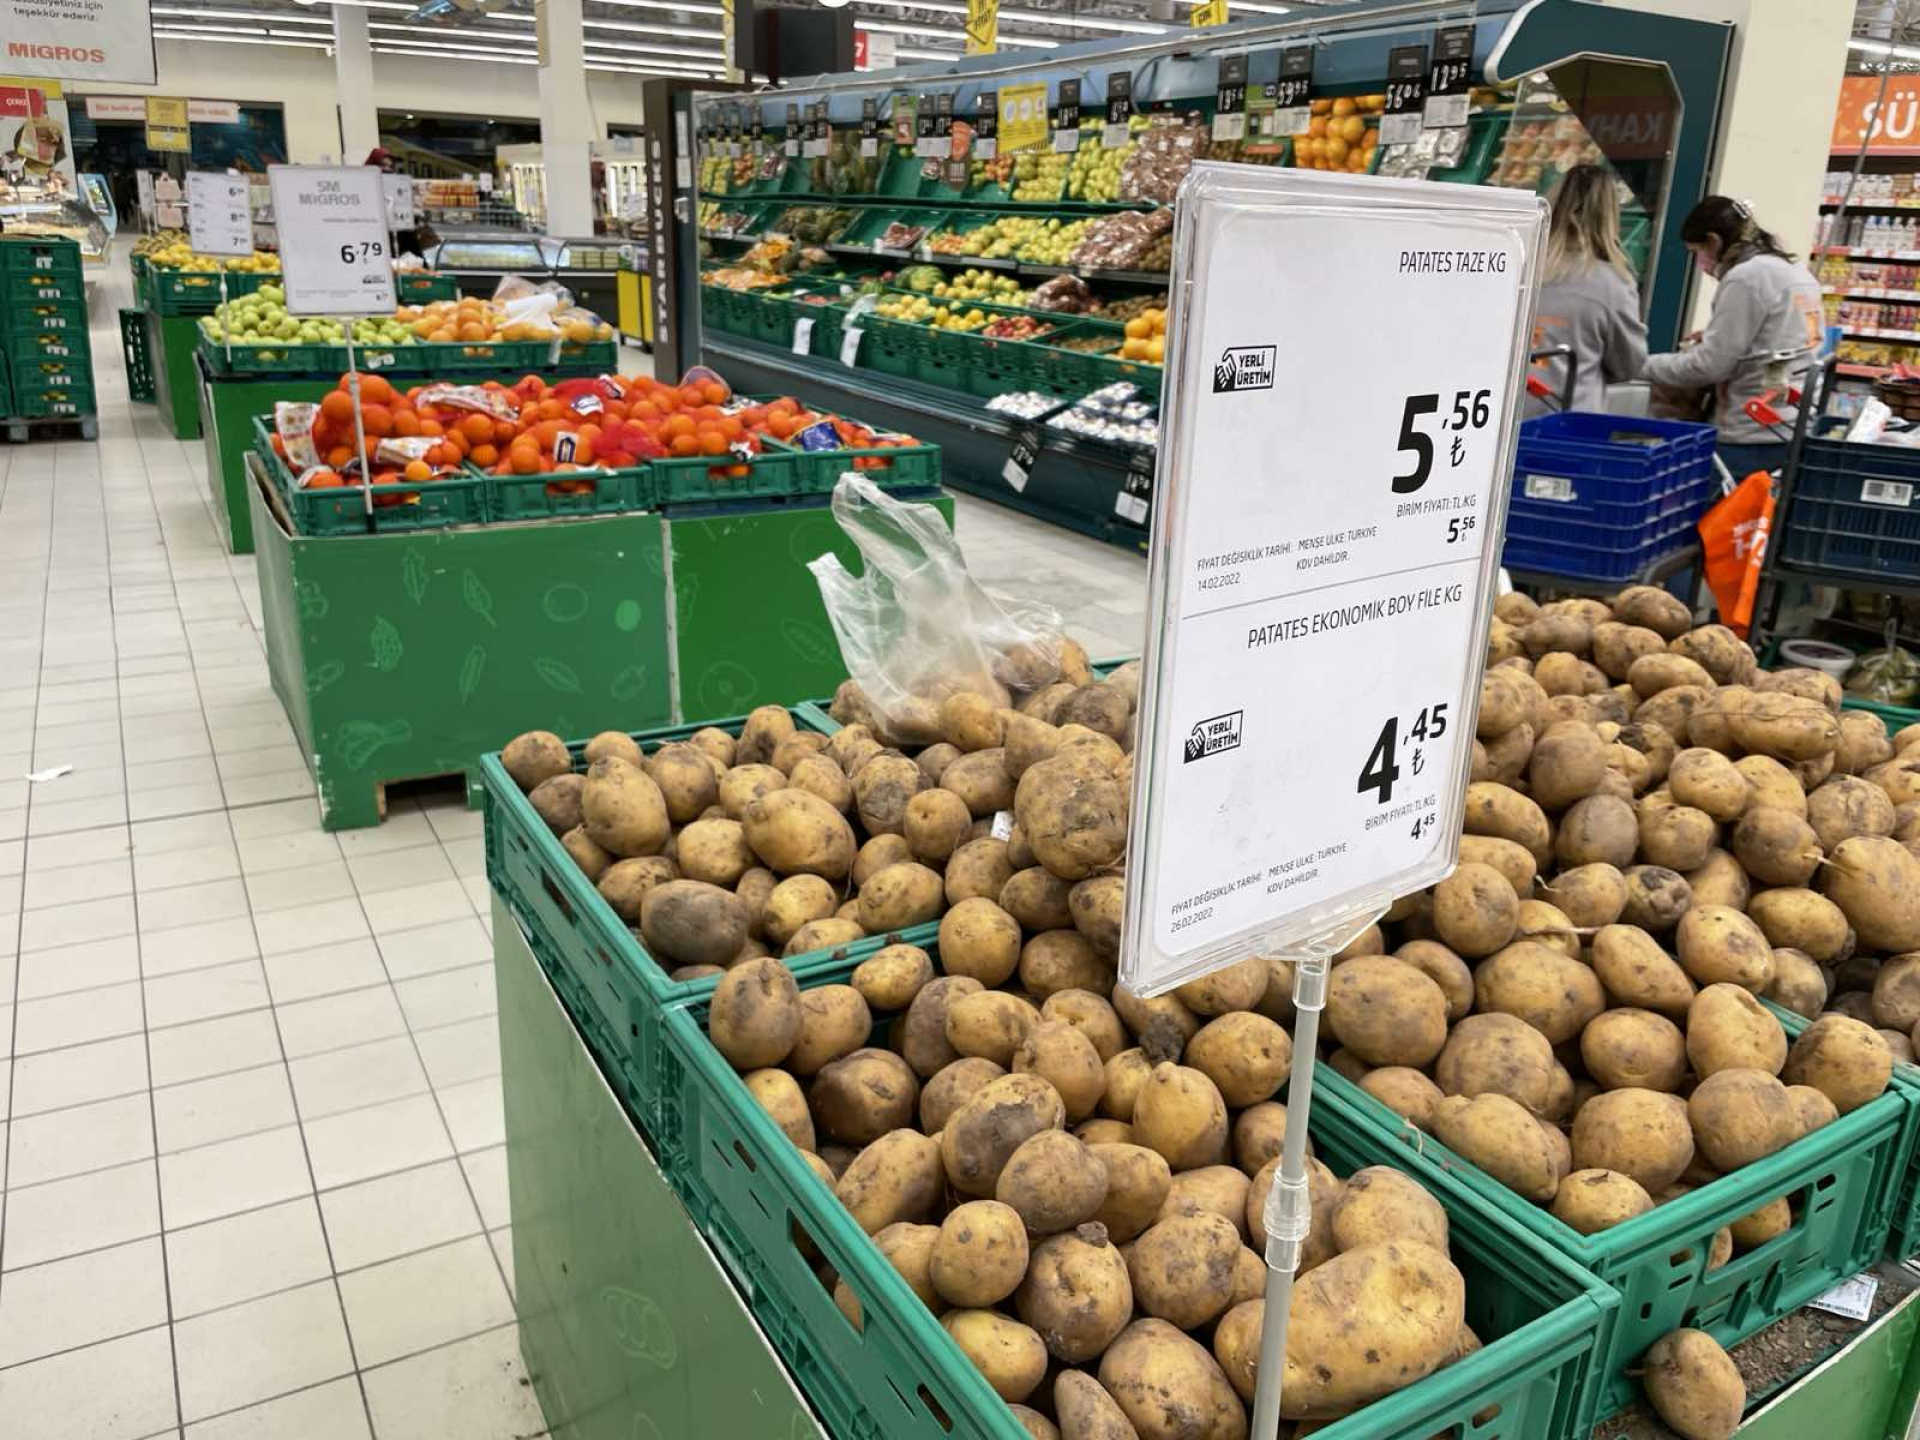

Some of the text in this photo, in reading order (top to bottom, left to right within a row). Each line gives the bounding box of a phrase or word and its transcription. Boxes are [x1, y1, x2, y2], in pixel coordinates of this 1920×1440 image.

[13, 7, 60, 18] teşekkür
[652, 140, 669, 344] STARBUCKS
[1399, 251, 1507, 273] PATATES TAZE KG
[1239, 350, 1266, 368] YERLİ
[1236, 367, 1272, 385] ÜRETİM
[1296, 557, 1313, 571] KDV
[1248, 583, 1463, 649] PATATES EKONOMİK BOY FİLE KG
[1207, 717, 1232, 736] YERLİ
[1205, 731, 1238, 751] ÜRETİM
